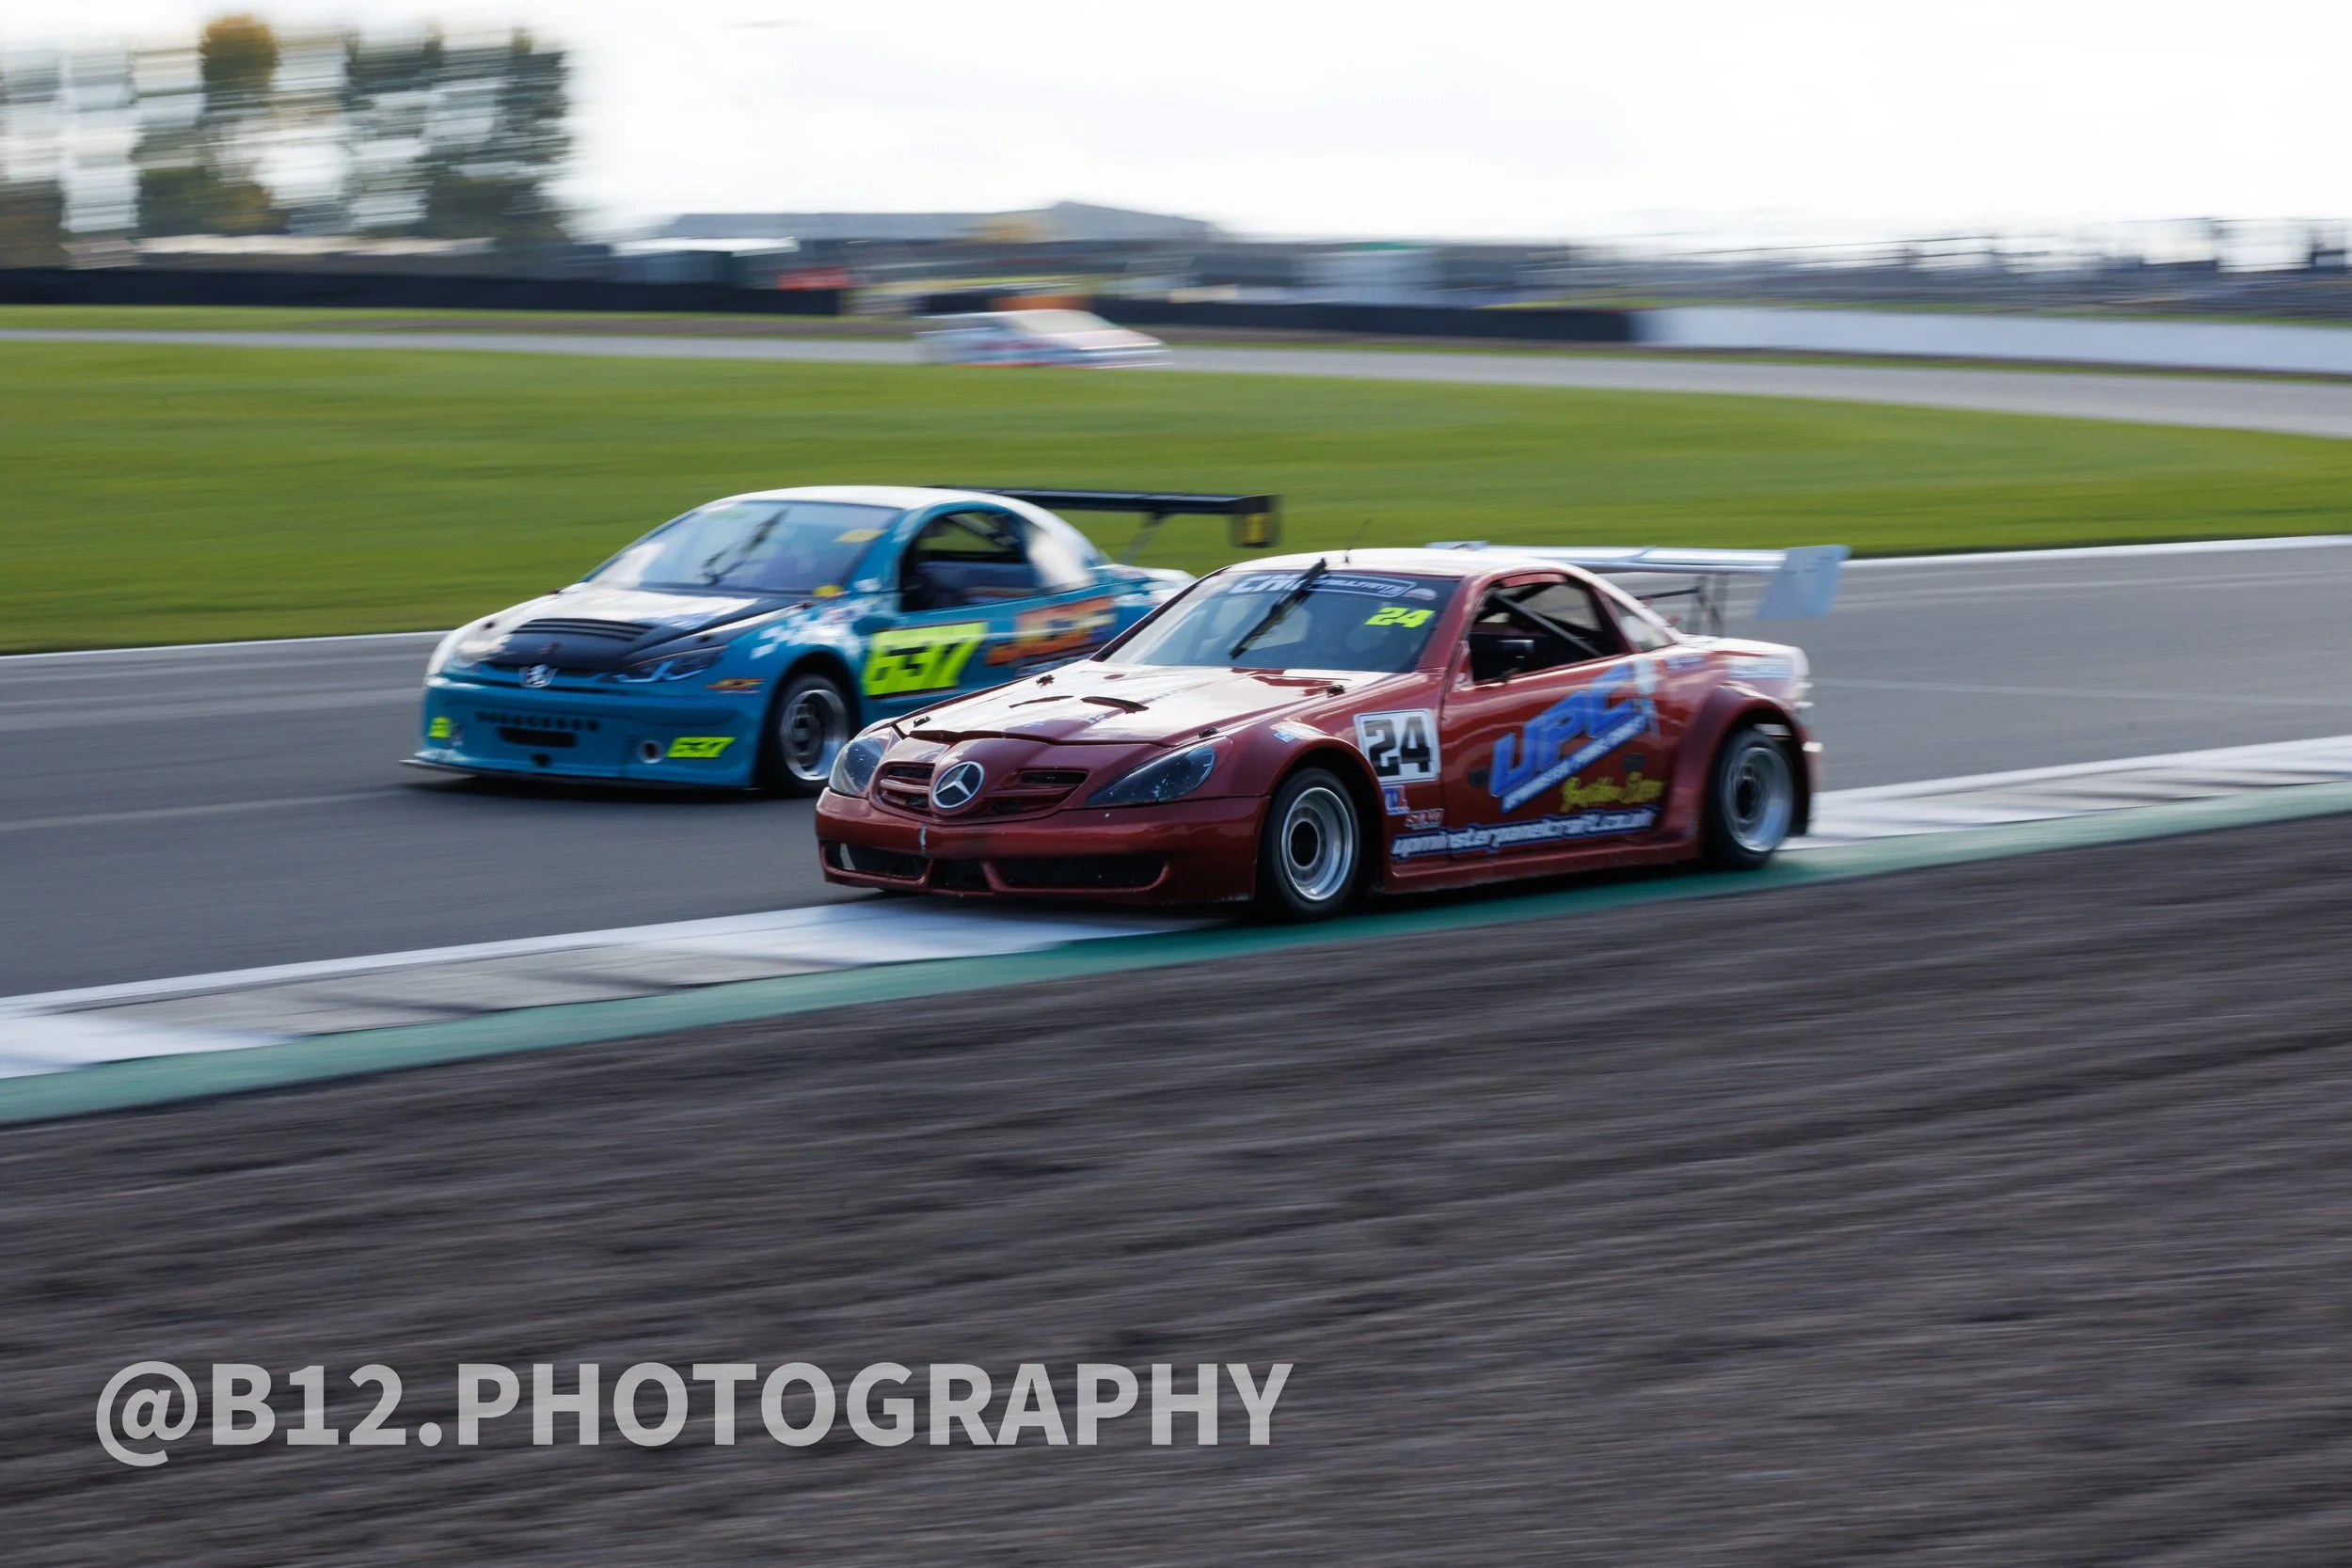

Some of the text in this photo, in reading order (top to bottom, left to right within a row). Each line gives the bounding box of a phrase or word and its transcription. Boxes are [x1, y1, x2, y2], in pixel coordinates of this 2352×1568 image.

[1364, 607, 1435, 628] 24
[863, 622, 987, 696] 637
[666, 736, 736, 758] 637
[1364, 717, 1432, 776] 24
[1490, 662, 1635, 797] UPC
